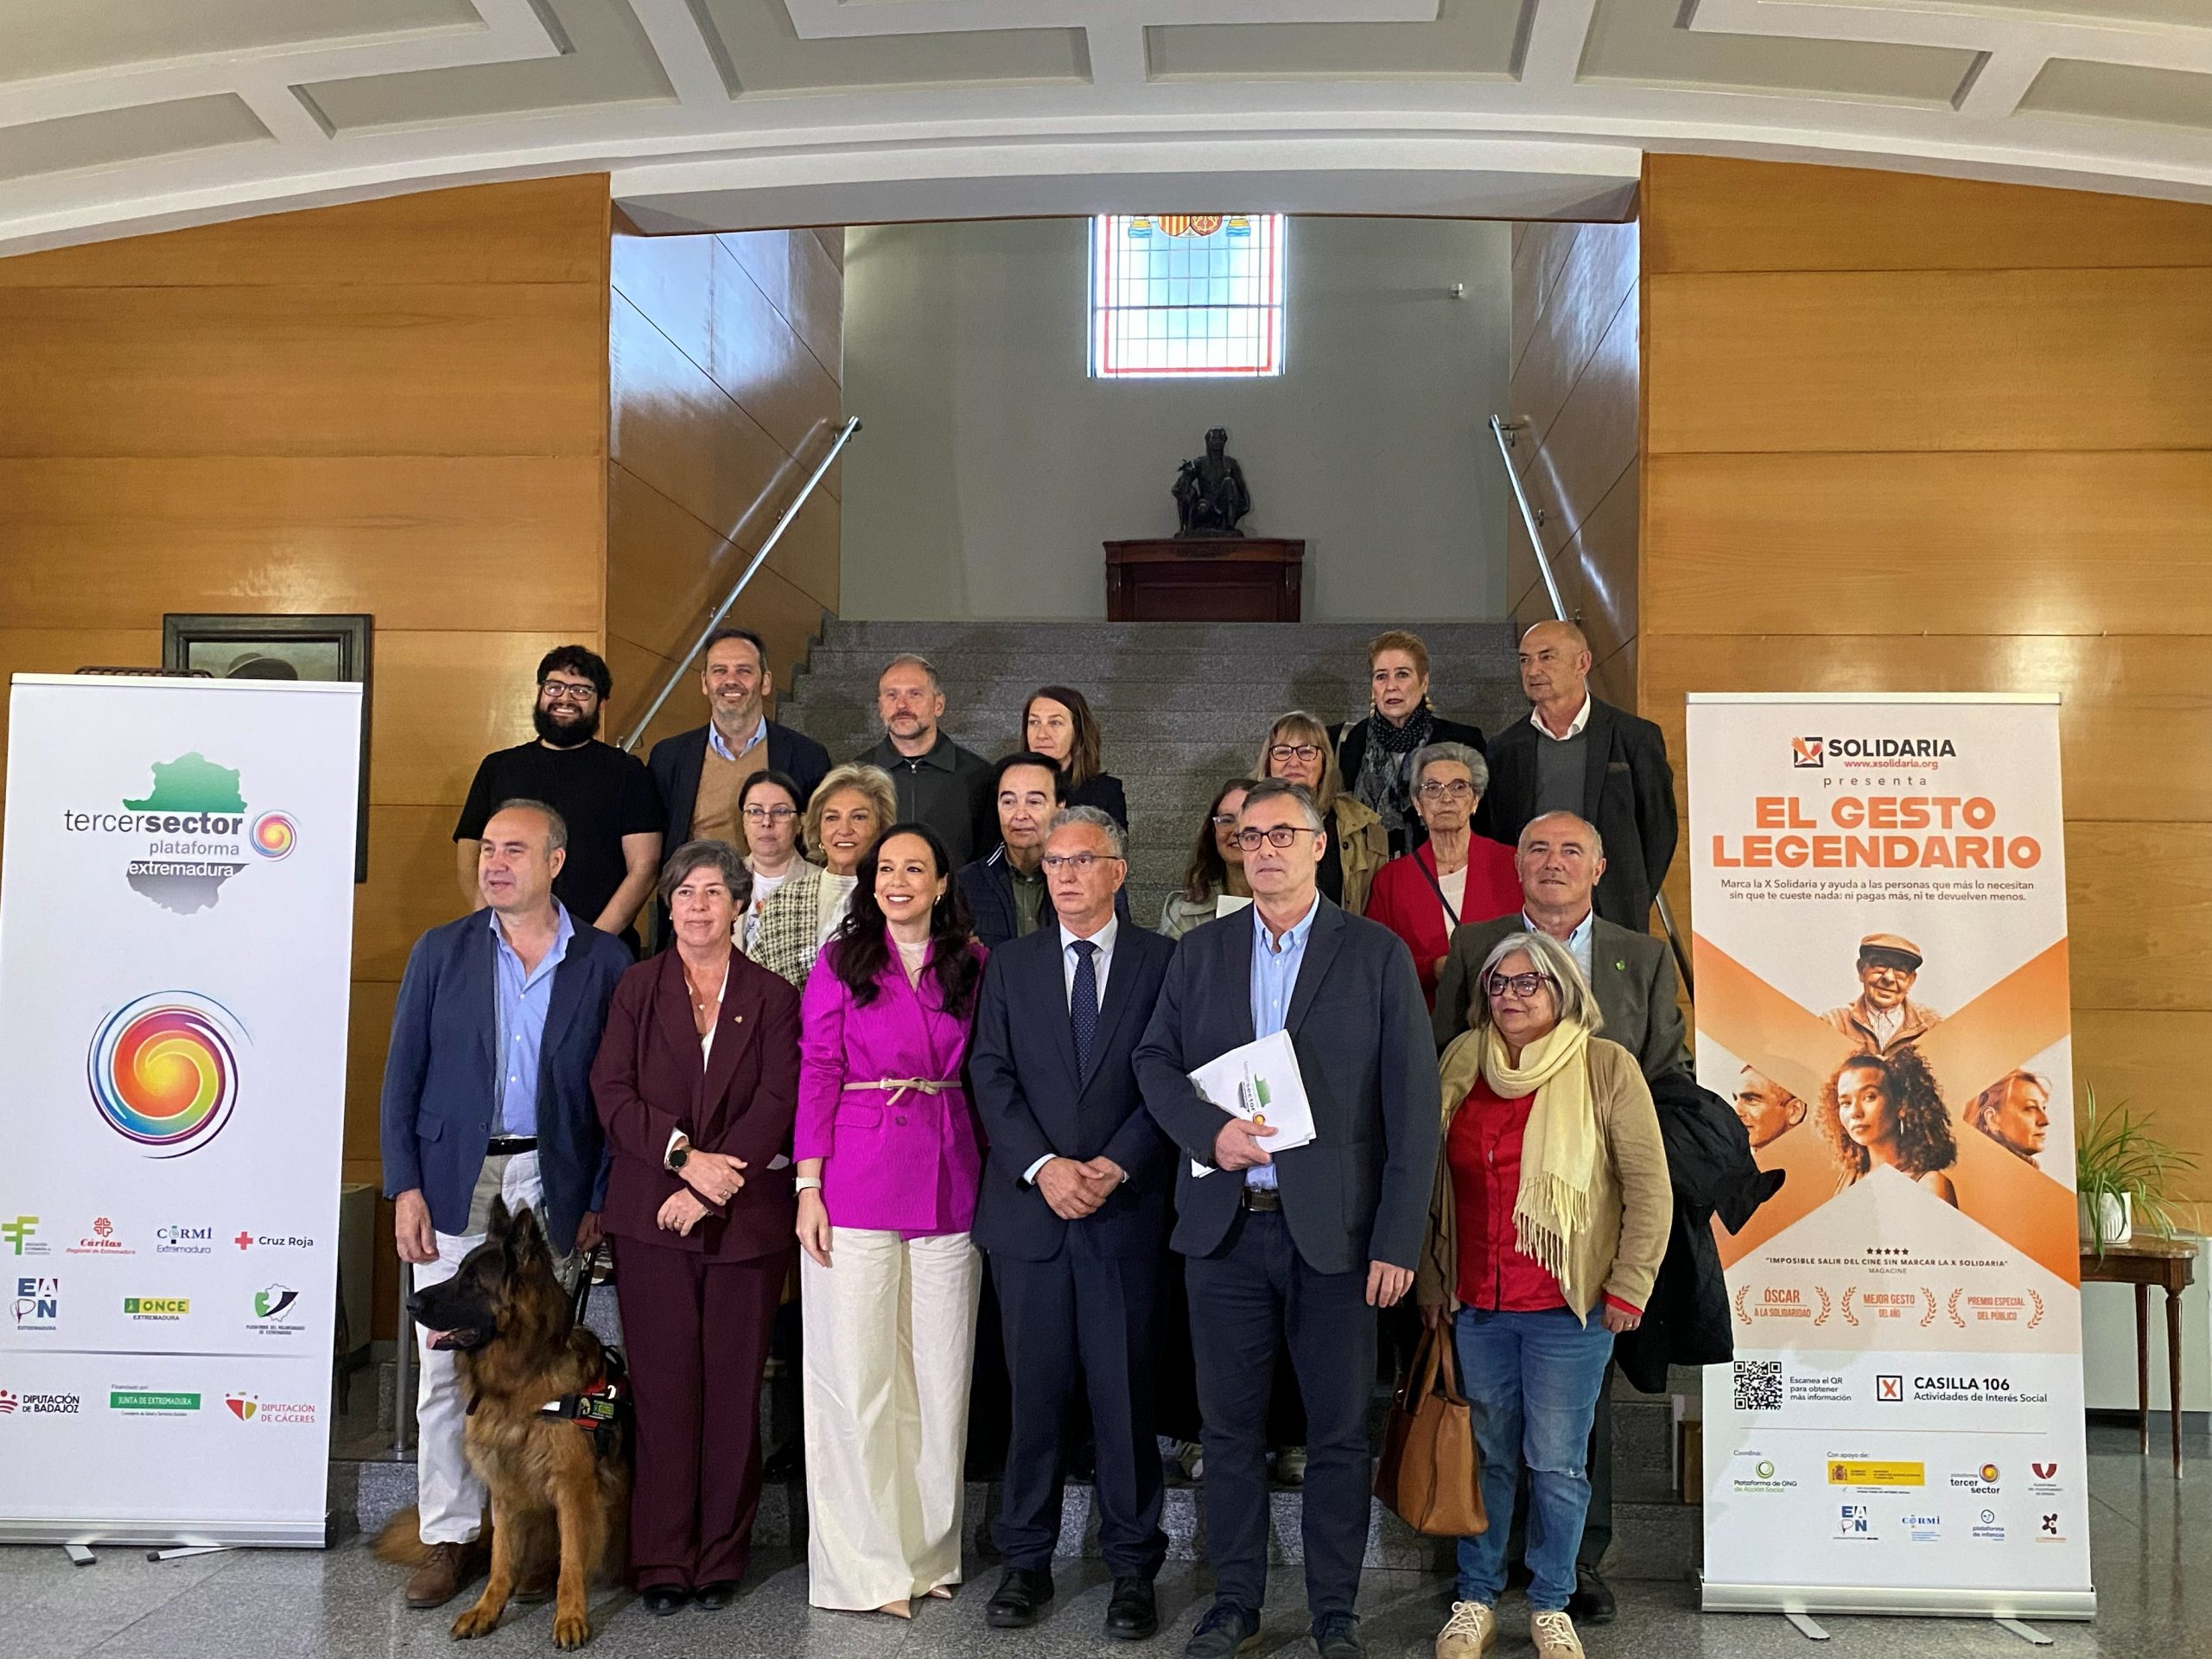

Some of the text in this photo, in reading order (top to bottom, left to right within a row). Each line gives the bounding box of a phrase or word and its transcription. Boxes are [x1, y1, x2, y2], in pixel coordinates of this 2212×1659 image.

[1828, 739, 1956, 757] SOLIDARIA
[1844, 758, 1938, 770] www.xsolidaria.org
[1823, 776, 1927, 788] presenta
[1756, 796, 1996, 830] EL GESTO
[64, 809, 243, 836] tercersector
[149, 839, 240, 857] plataforma
[1713, 835, 2041, 868] LEGENDARIO
[129, 861, 235, 878] extremadura
[1721, 880, 1751, 888] Marca
[1754, 880, 1762, 888] la
[1764, 880, 1772, 888] X
[1774, 880, 1817, 888] Solidaria
[1820, 881, 1826, 891] y
[1827, 880, 1858, 891] ayuda
[1869, 880, 1882, 888] las
[1885, 881, 1930, 891] personas
[1932, 882, 1951, 892] que
[1953, 880, 1973, 889] más
[1975, 880, 1985, 889] lo
[1987, 880, 2034, 890] necesitan
[1730, 891, 2026, 902] sin que te cueste nada: ni pagas más, ni te devuelven menos.
[80, 1238, 123, 1248] Cáritas
[259, 1236, 314, 1249] Cruz Roja
[156, 1244, 211, 1254] Extremadura
[1764, 1286, 1801, 1303] ÓSCAR
[1863, 1294, 1915, 1305] MEJOR GESTO
[143, 1300, 187, 1313] ONCE
[1754, 1308, 1811, 1318] A LA SOLIDARIDAD
[1914, 1376, 2010, 1391] CASILLA 106
[22, 1392, 79, 1404] DIPUTACIÓN
[118, 1396, 192, 1405] JUNTA DE EXTREMADURA
[1913, 1392, 2048, 1402] Actividades de Interés Social
[35, 1405, 79, 1414] BADAJOZ
[261, 1402, 315, 1413] DIPUTACIÓN
[261, 1414, 315, 1423] DE CÁCERES
[1950, 1478, 1979, 1487] tercer
